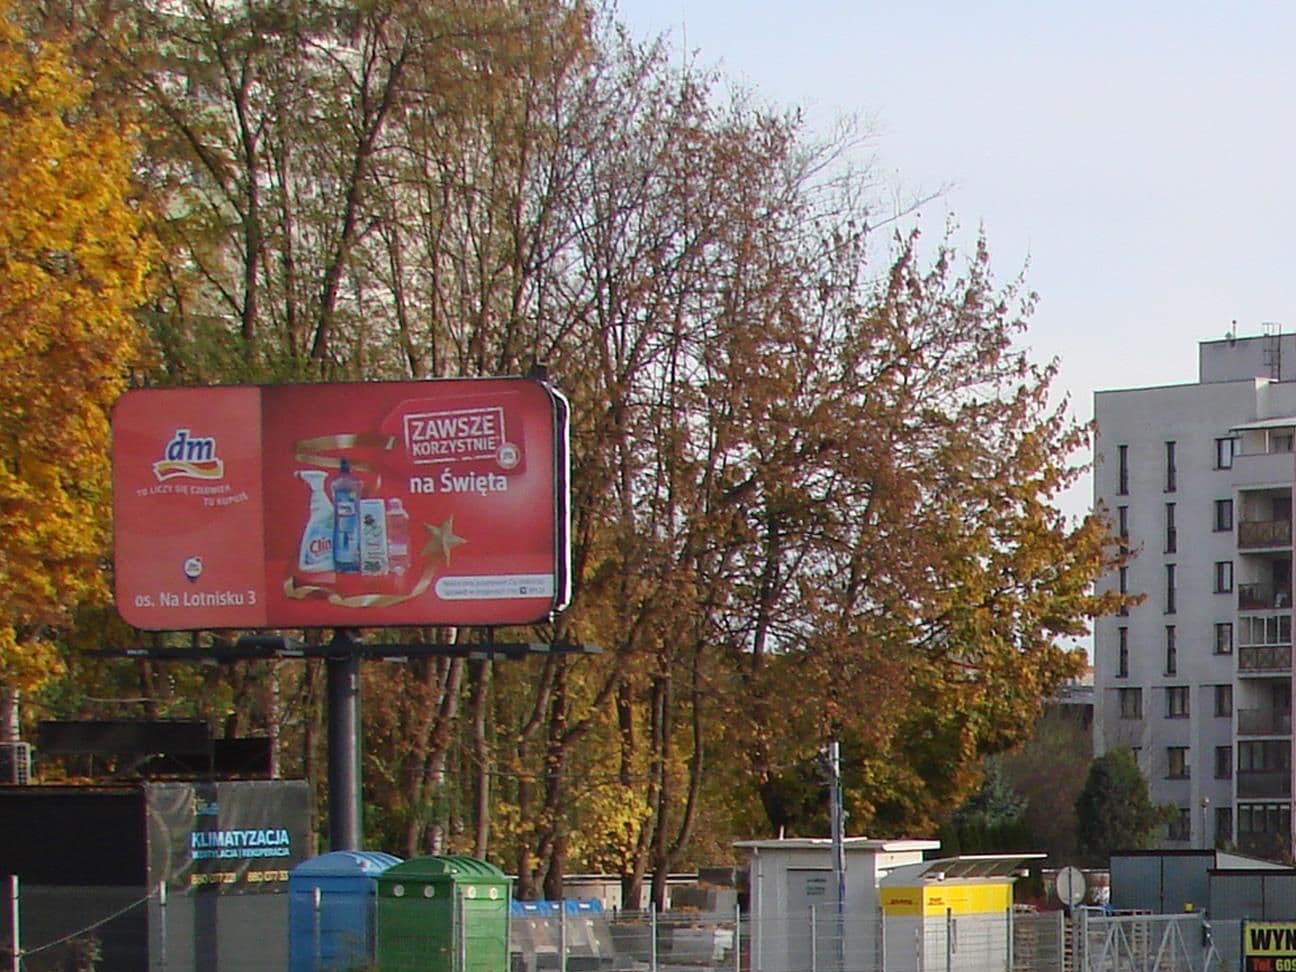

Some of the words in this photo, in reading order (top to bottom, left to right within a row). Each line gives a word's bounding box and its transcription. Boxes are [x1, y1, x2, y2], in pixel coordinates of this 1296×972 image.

[412, 416, 495, 440] ZAWSZE
[167, 430, 214, 461] dm
[412, 438, 497, 456] KORZYSTNIE
[410, 477, 435, 493] na
[440, 467, 508, 496] Święta
[134, 594, 155, 607] os.
[160, 591, 180, 607] Na
[183, 591, 244, 607] Lotnisku
[247, 590, 257, 605] 3
[192, 830, 290, 848] KLIMATYZACJA
